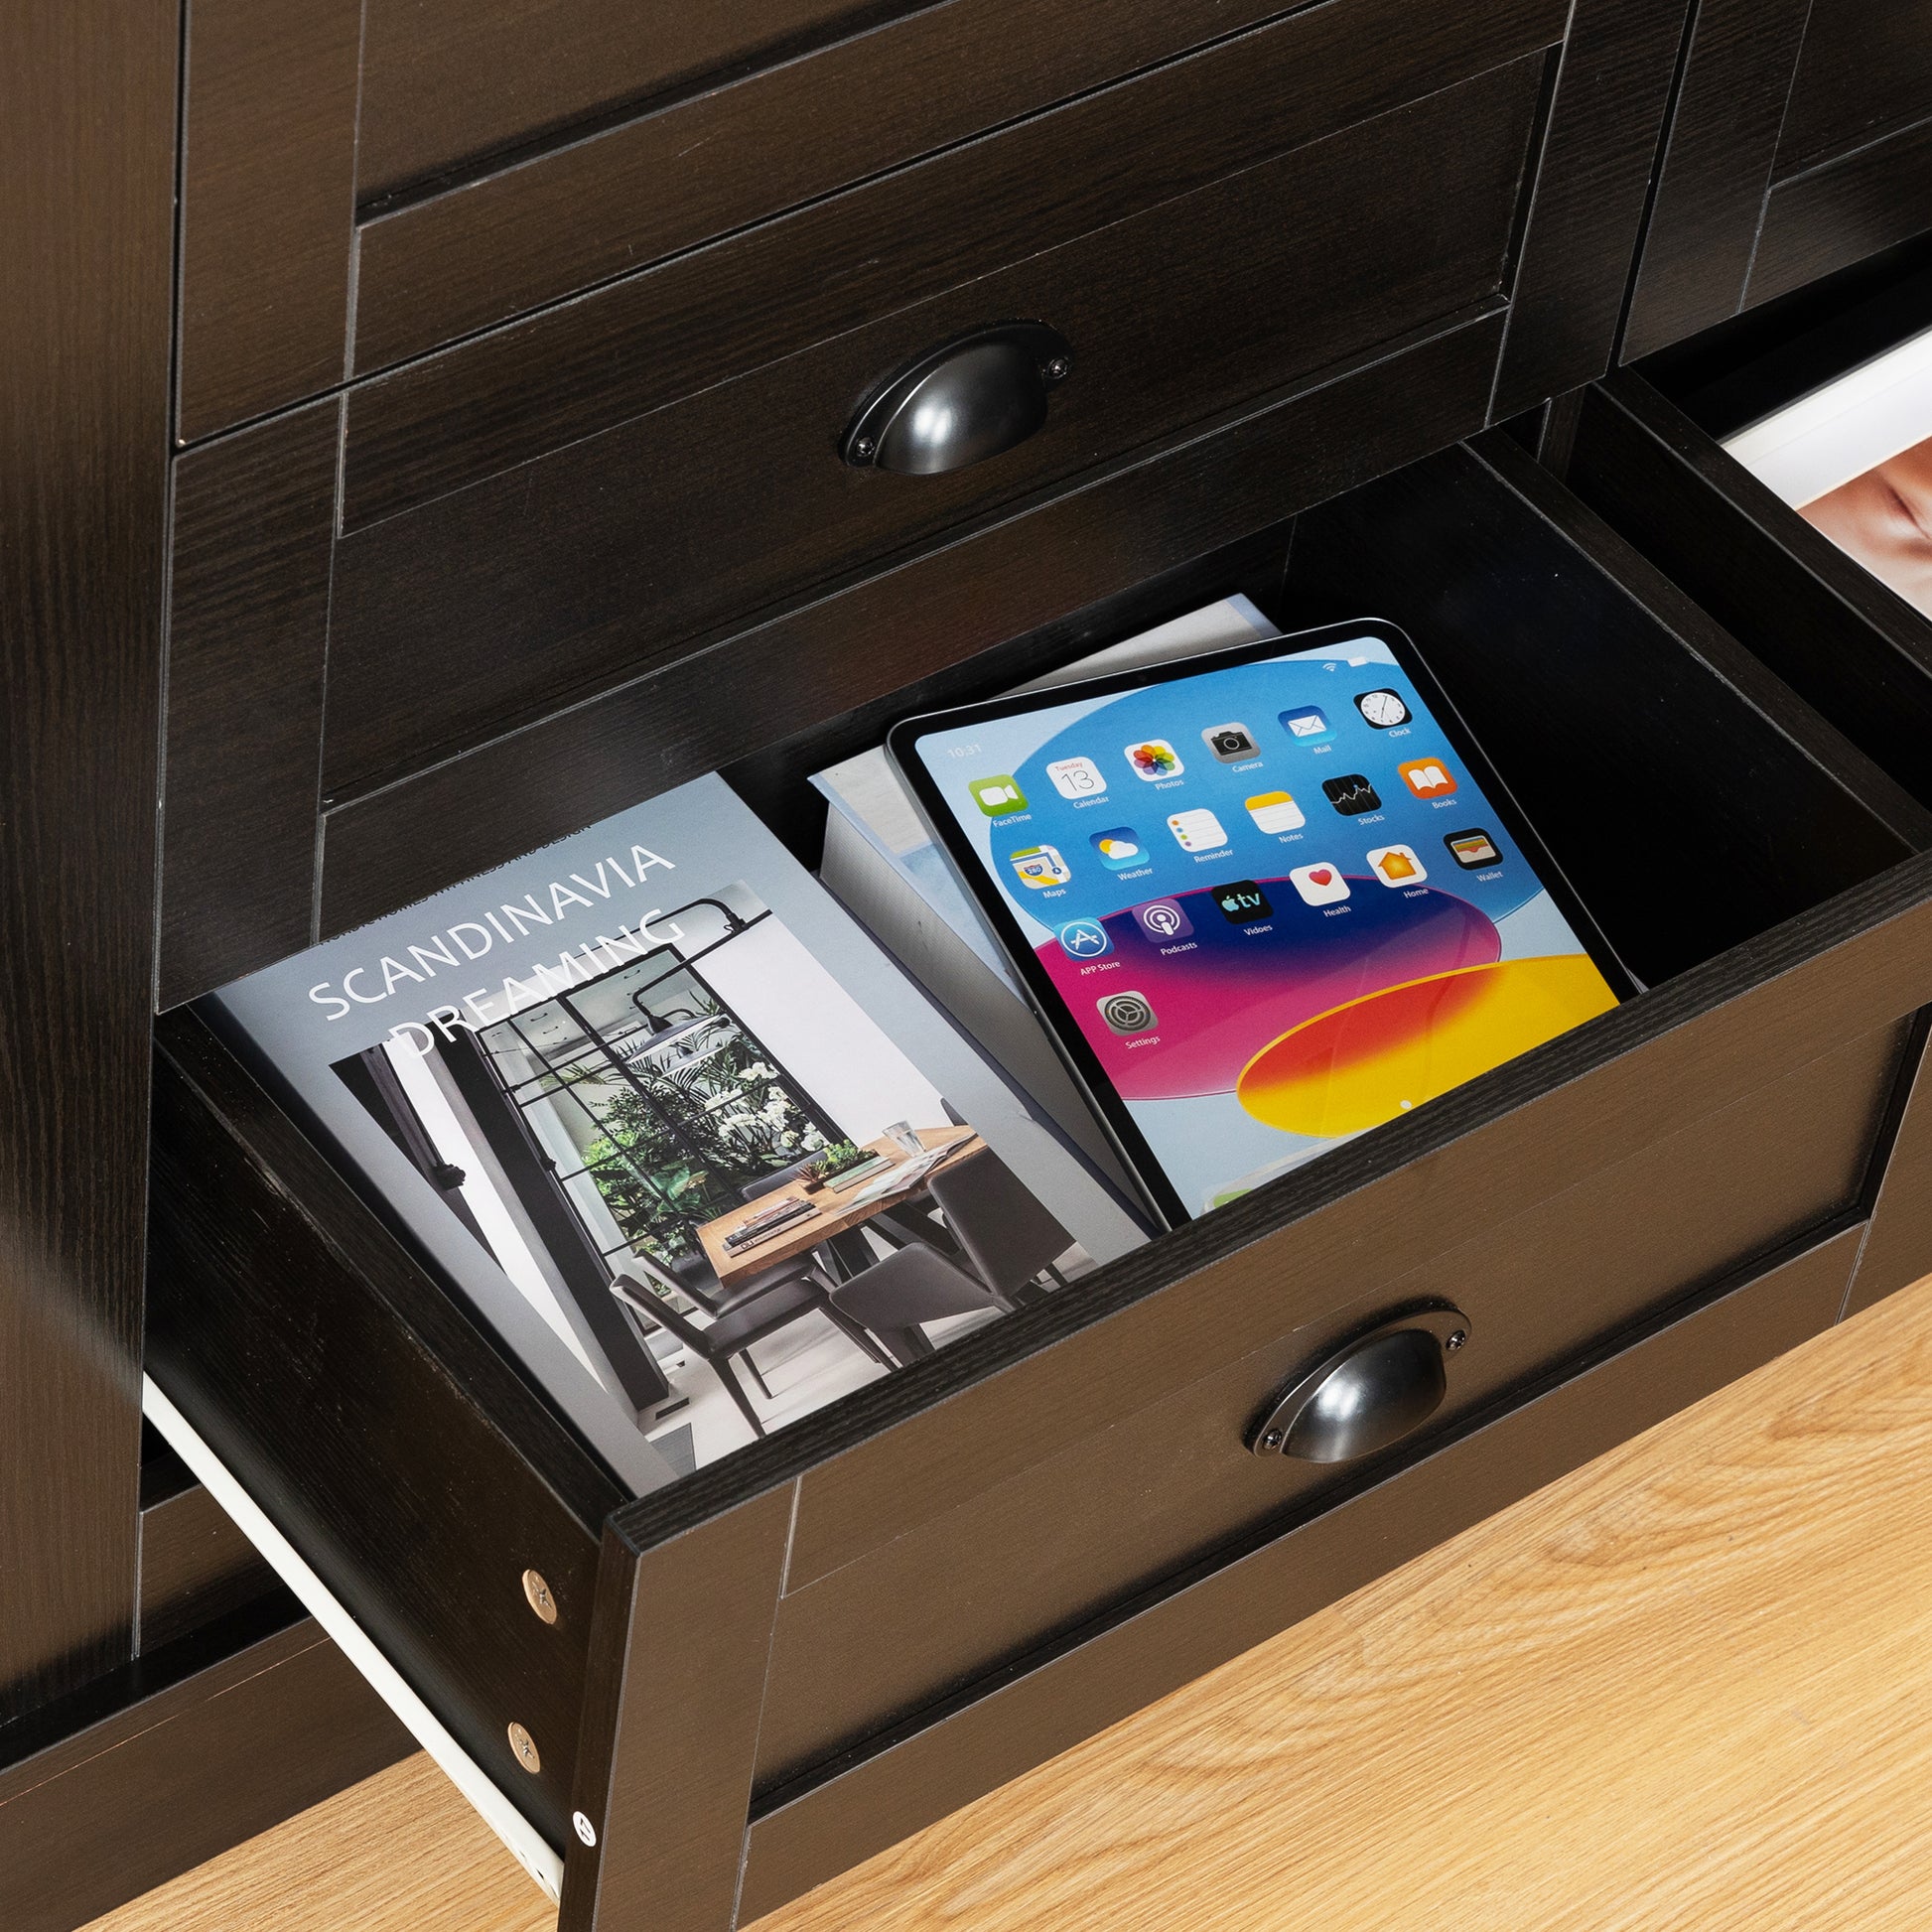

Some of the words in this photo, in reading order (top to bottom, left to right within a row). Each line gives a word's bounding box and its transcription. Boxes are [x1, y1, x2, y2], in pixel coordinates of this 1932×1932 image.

[1389, 727, 1412, 739] Clock
[947, 744, 982, 759] 10:31
[1312, 745, 1331, 756] Mail
[1055, 761, 1083, 772] Tuesday
[1232, 760, 1264, 773] Camera
[1061, 769, 1095, 791] 13
[1154, 778, 1184, 791] Photos
[1073, 795, 1109, 809] Calendar
[1432, 798, 1457, 810] Books
[992, 813, 1033, 828] FaceTime
[1358, 814, 1385, 826] Stocks
[1279, 832, 1304, 844] Notes
[1193, 848, 1233, 864] Reminder
[1117, 867, 1154, 882] Weather
[1476, 871, 1503, 883] Wallet
[1042, 889, 1066, 899] Maps
[1403, 887, 1429, 899] Home
[1237, 893, 1261, 908] tv
[1322, 904, 1351, 917] Health
[309, 844, 676, 1022] SCANDINAVIA
[1243, 924, 1273, 936] Vidoes
[1160, 941, 1198, 956] Podcasts
[1080, 965, 1096, 976] APP
[1097, 960, 1121, 972] Store
[388, 908, 686, 1060] DREAMING
[1125, 1035, 1161, 1050] Settings
